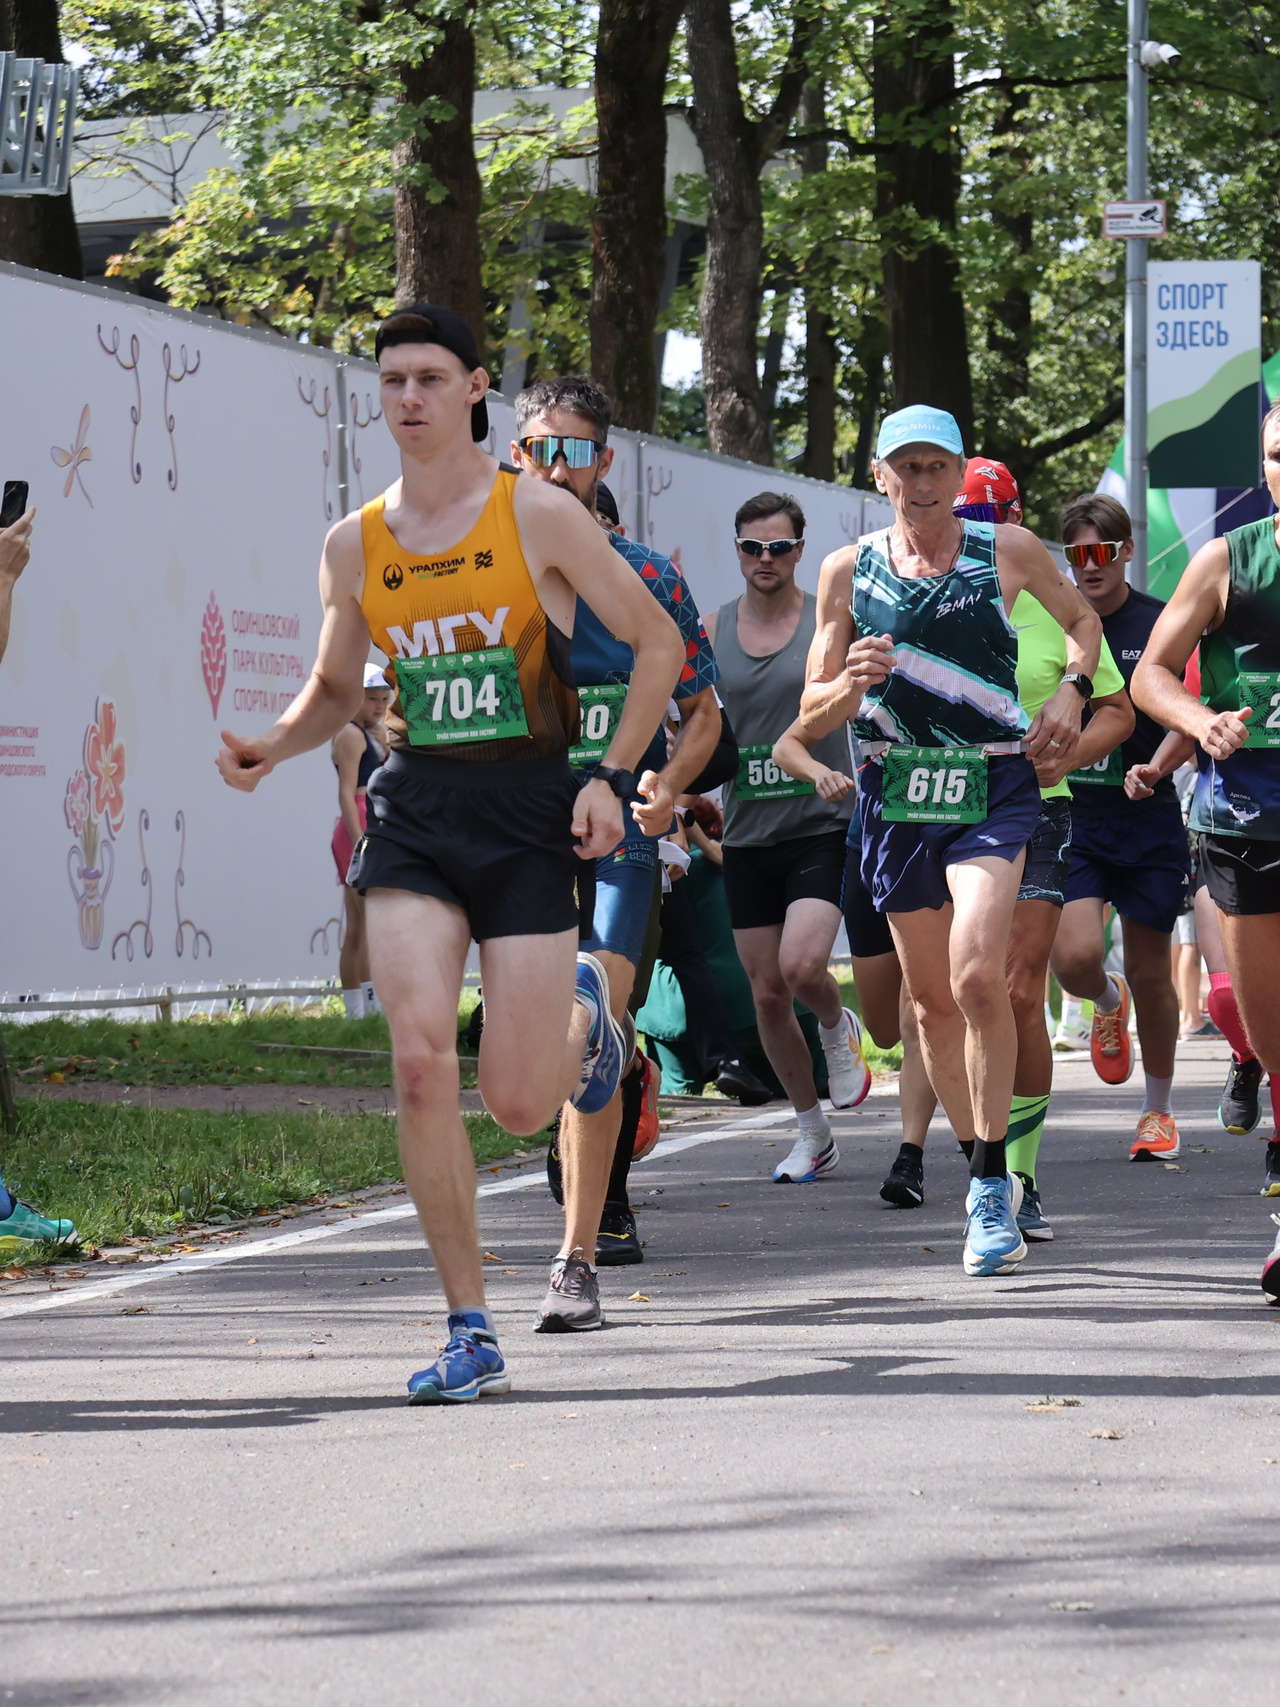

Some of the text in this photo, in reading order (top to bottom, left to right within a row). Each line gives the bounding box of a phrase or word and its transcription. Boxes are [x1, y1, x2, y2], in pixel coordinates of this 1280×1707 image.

[1158, 283, 1228, 311] СПОРТ
[1156, 320, 1229, 351] ЗДЕСЬ
[408, 557, 466, 575] УРАЛХИМ
[232, 609, 300, 639] ОДИНЦОВСКИЙ
[386, 606, 510, 660] МГУ
[232, 648, 257, 673] ПАРК
[1121, 650, 1142, 659] EA7
[234, 687, 267, 713] СПОРТА
[270, 690, 278, 714] И
[425, 673, 500, 721] 704
[907, 767, 968, 804] 615
